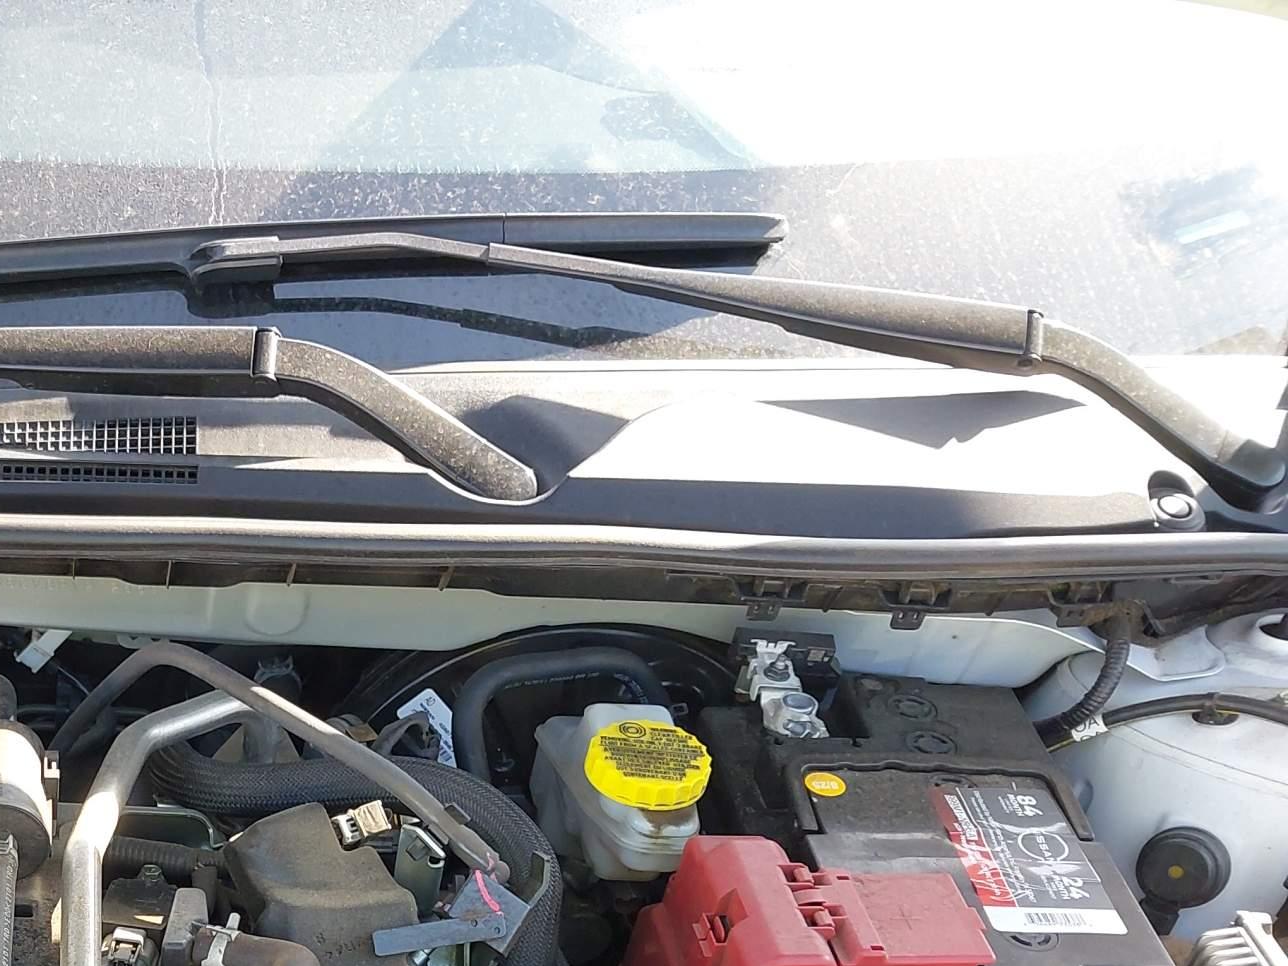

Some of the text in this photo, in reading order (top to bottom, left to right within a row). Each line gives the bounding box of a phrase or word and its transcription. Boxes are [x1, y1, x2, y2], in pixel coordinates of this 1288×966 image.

[1007, 793, 1025, 817] MONTH
[1015, 795, 1043, 817] 84
[1061, 876, 1090, 900] 24
